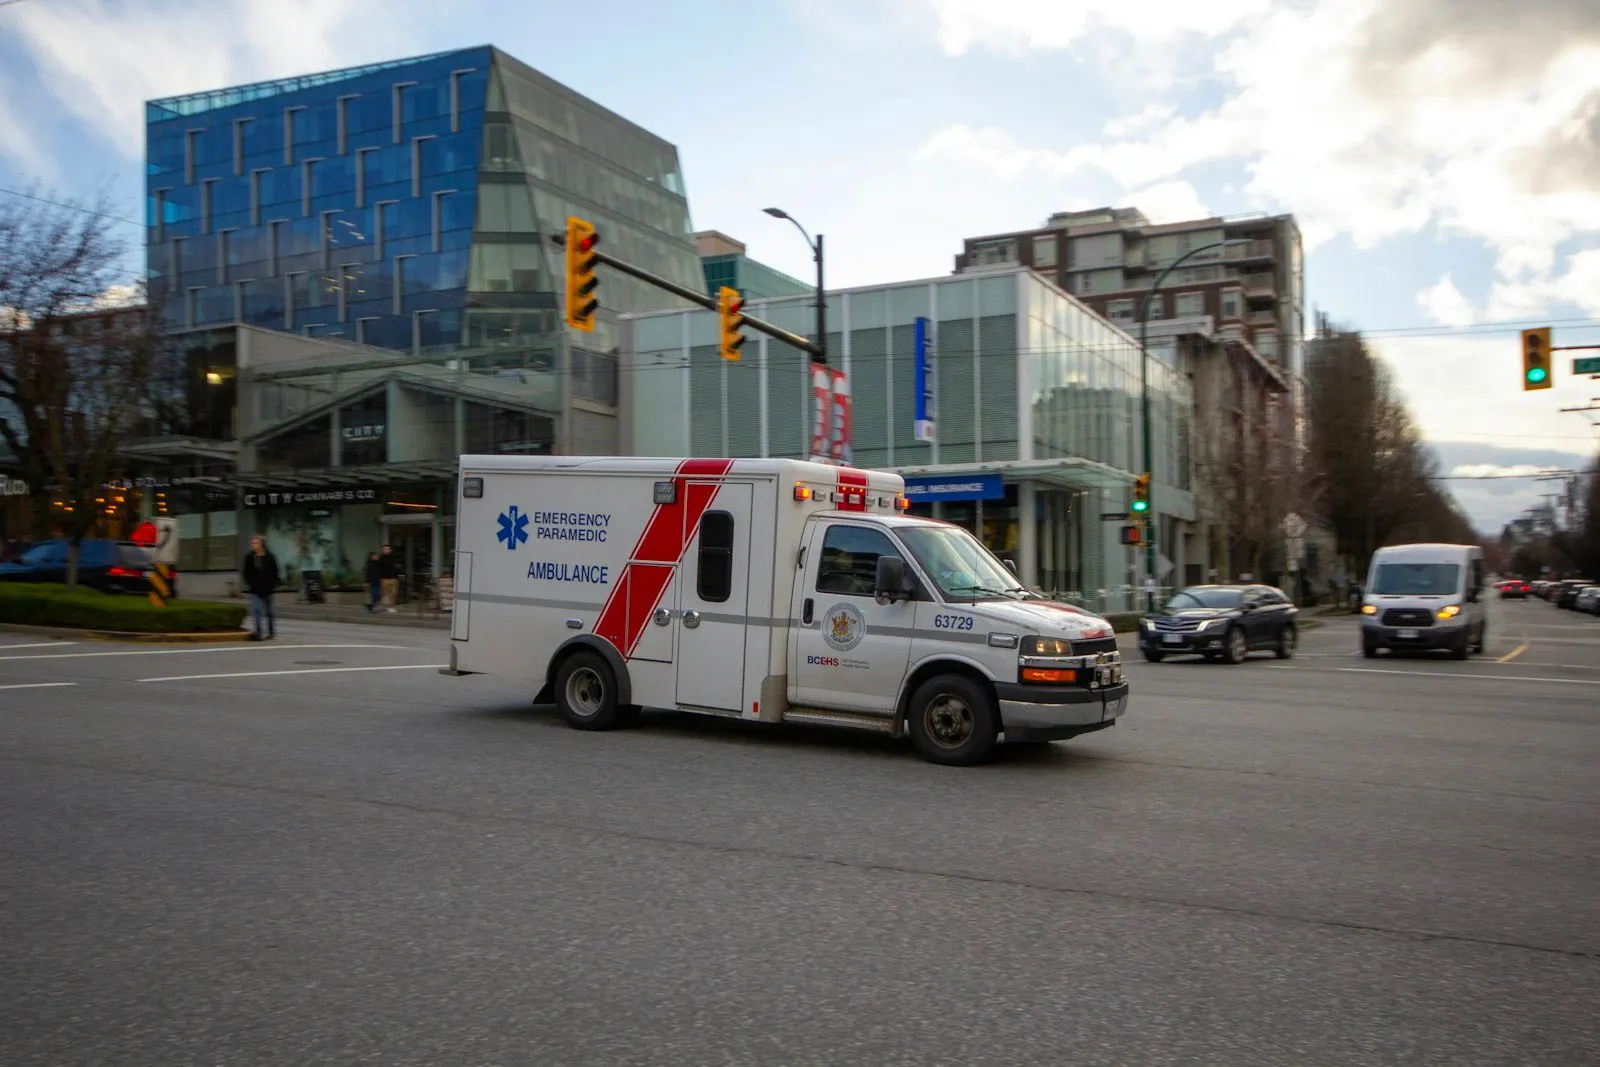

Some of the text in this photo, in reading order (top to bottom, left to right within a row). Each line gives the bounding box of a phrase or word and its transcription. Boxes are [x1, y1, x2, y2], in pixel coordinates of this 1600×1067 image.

[343, 425, 385, 437] CITY
[244, 492, 293, 506] CITY
[534, 511, 611, 527] EMERGENCY
[537, 527, 608, 543] PARAMEDIC
[527, 561, 609, 584] AMBULANCE
[934, 614, 974, 631] 63729
[807, 655, 839, 667] BCEHS
